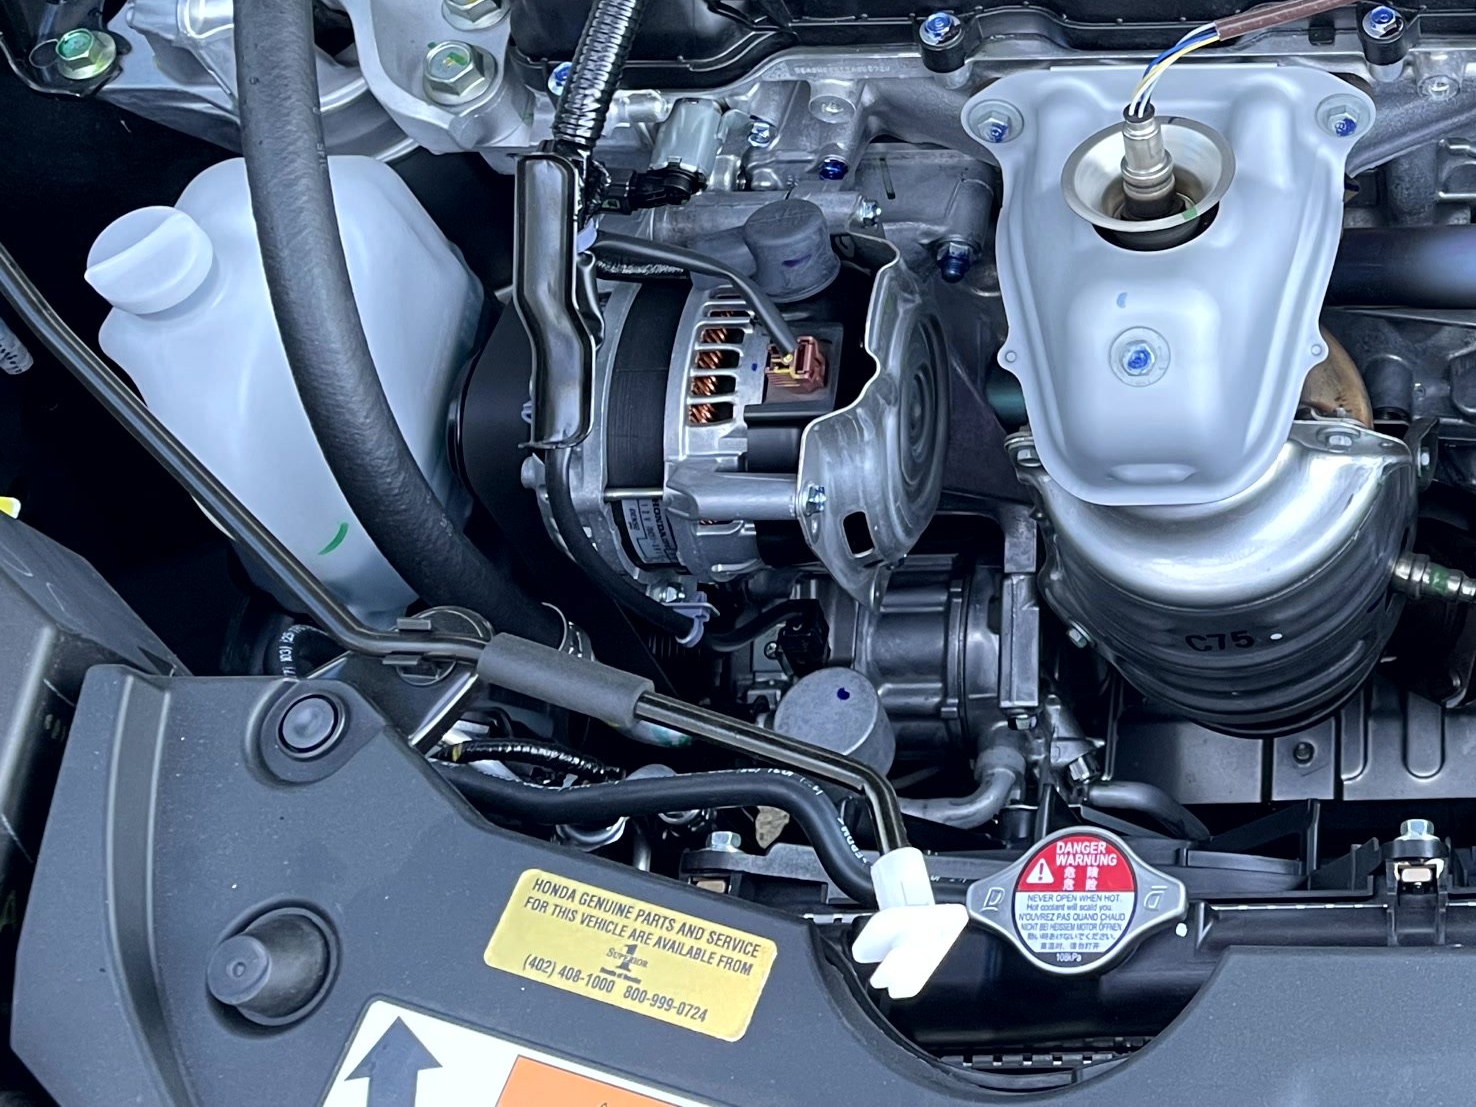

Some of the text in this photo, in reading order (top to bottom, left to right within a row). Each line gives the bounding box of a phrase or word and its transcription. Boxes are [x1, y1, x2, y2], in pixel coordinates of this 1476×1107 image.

[1185, 630, 1255, 652] C75
[1056, 842, 1107, 854] DANGER
[1056, 854, 1118, 866] WARNUNG
[1027, 894, 1054, 902] NEVER
[1055, 894, 1077, 902] OPEN
[1079, 894, 1102, 902] WHEN
[532, 877, 762, 959] HONDA GENUINE PARTS AND SERVICE
[1056, 913, 1071, 921] PAS
[1072, 913, 1099, 921] QUAND
[1100, 913, 1126, 921] CHAUD
[524, 896, 755, 977] FOR THIS VEHICLE ARE AVAILABLE FROM
[1056, 953, 1082, 962] 108kPa
[523, 953, 709, 1023] (402) 408-1000 800-999-0724
